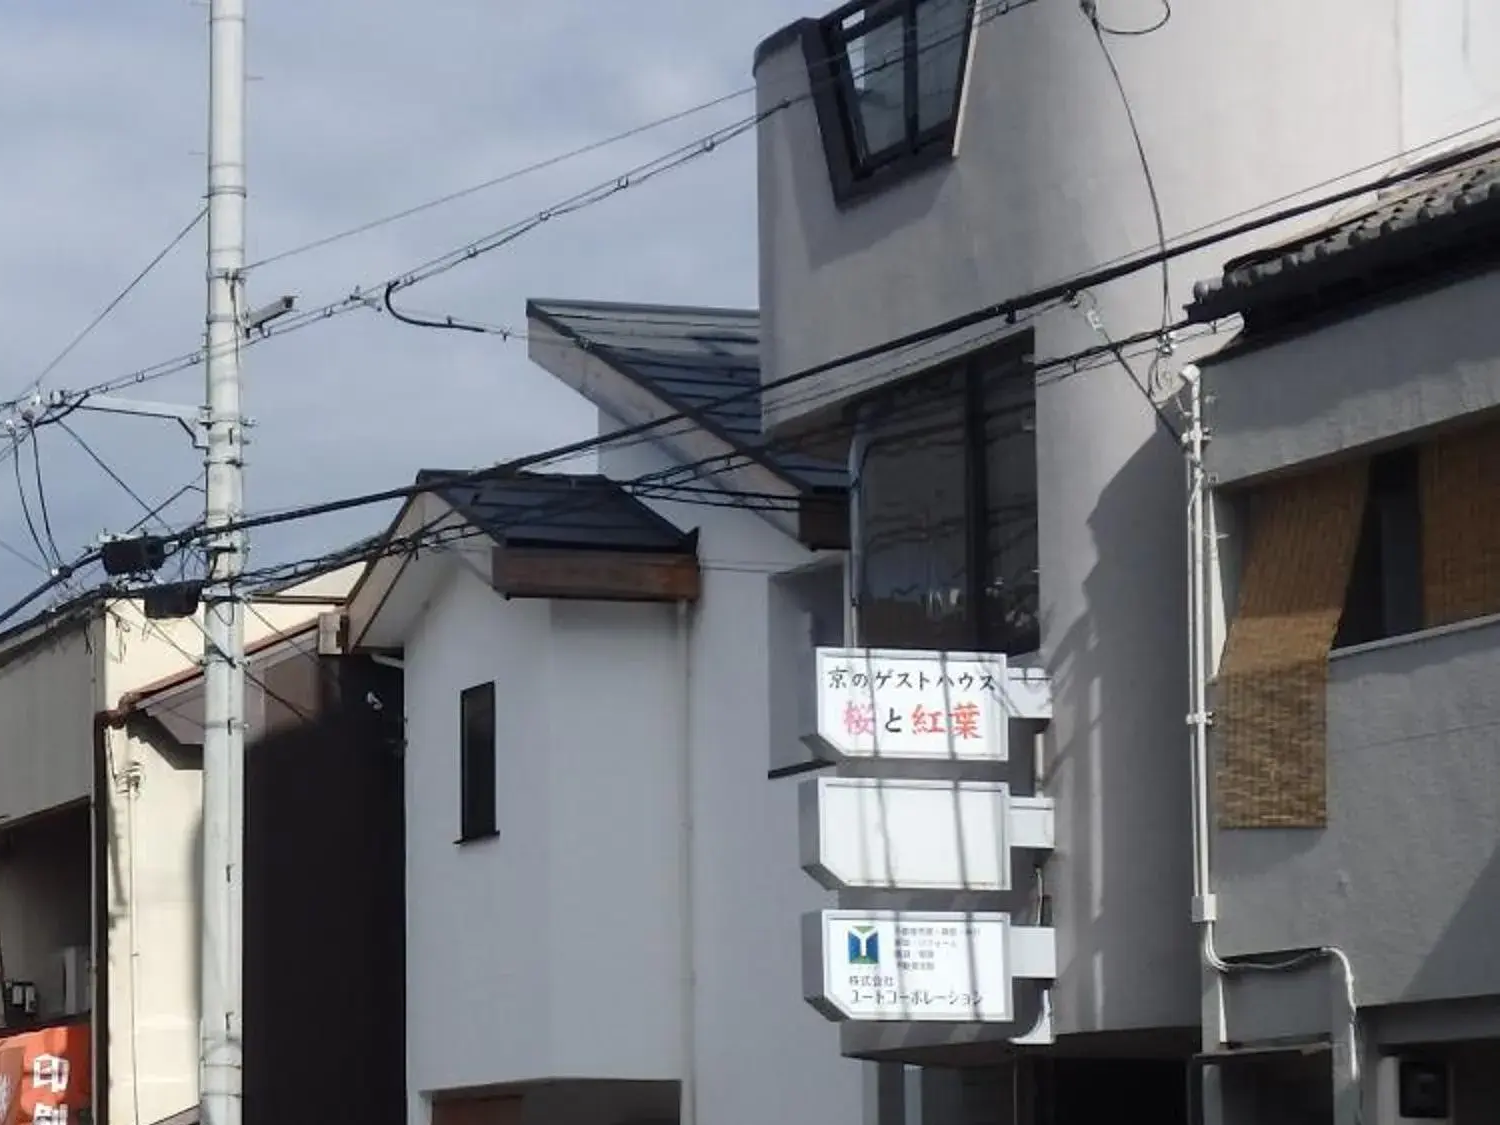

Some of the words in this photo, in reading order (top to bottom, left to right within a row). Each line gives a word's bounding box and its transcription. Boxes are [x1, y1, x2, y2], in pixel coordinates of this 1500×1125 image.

[828, 665, 995, 691] 京のゲストハウス
[844, 701, 983, 740] 桜と紅葉
